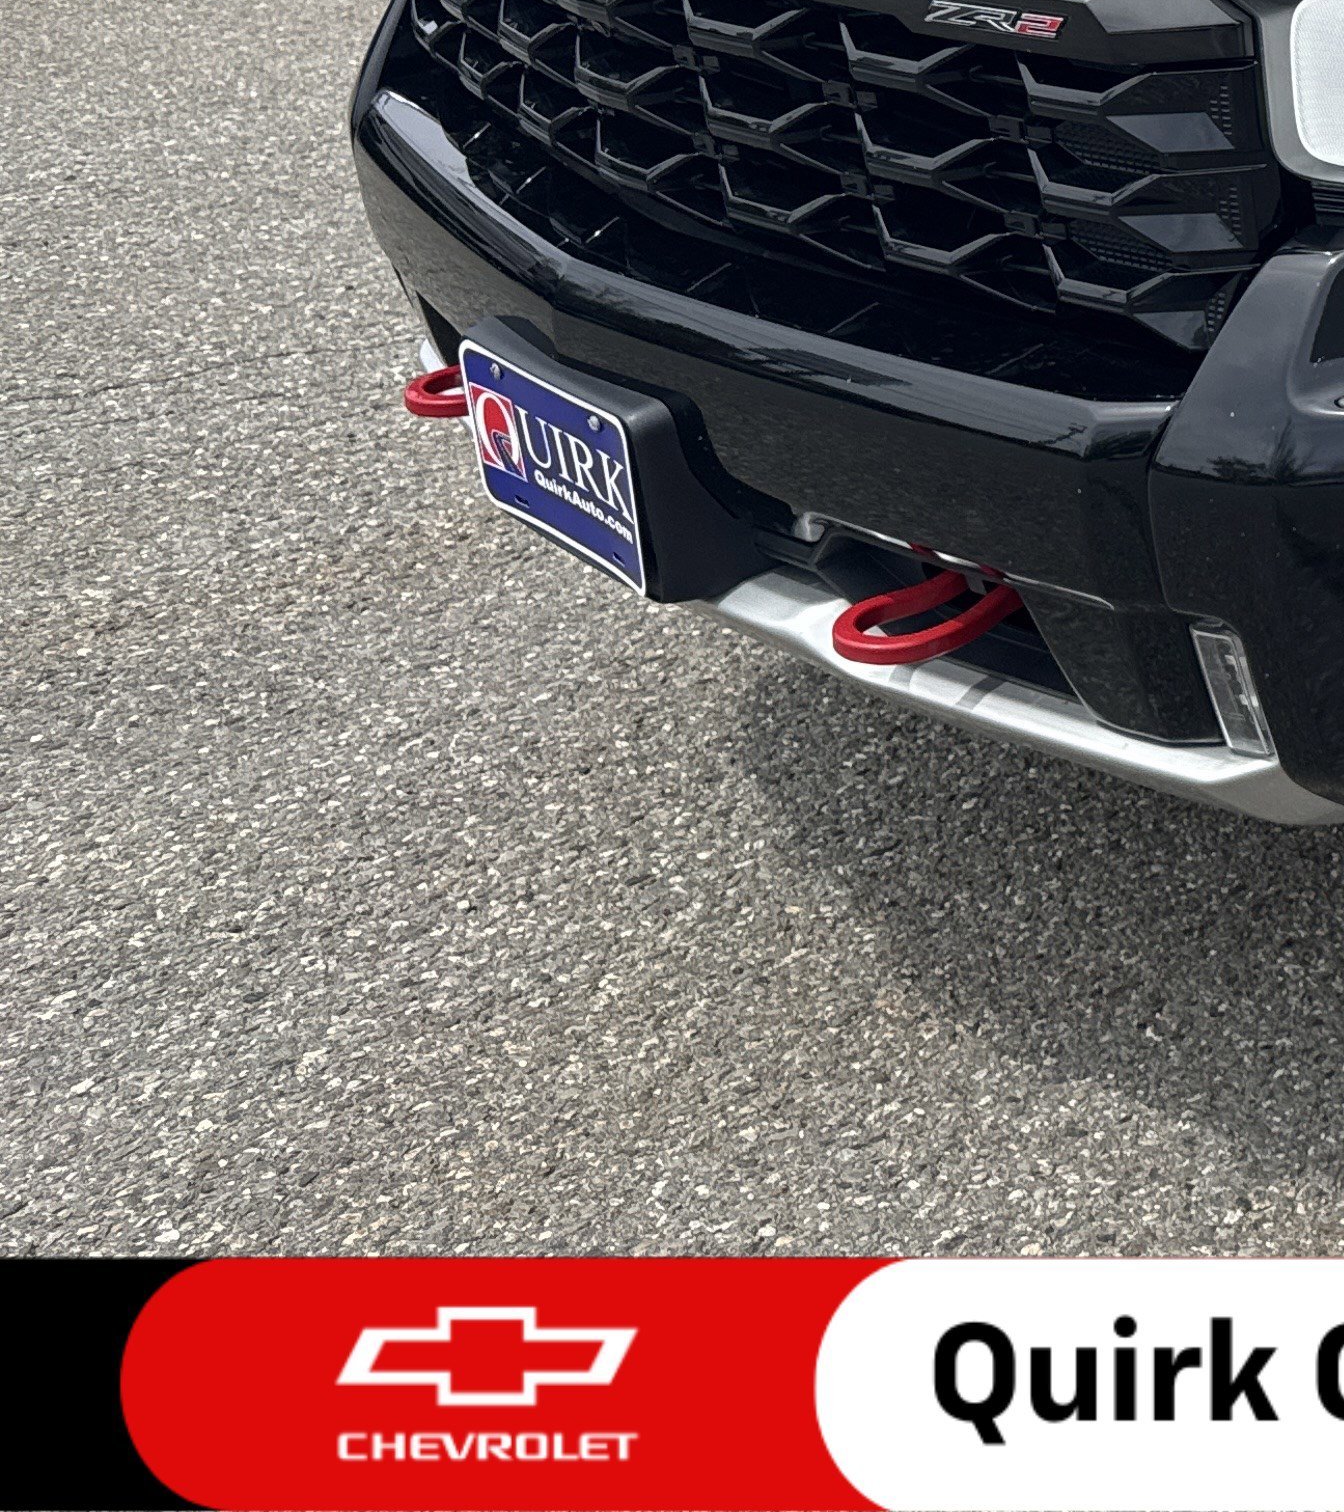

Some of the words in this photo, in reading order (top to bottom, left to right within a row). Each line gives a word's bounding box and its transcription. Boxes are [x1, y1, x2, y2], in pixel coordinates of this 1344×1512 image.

[924, 0, 1066, 39] ZR2
[474, 390, 636, 525] QUIRK
[533, 469, 635, 545] QuirkAuto.com
